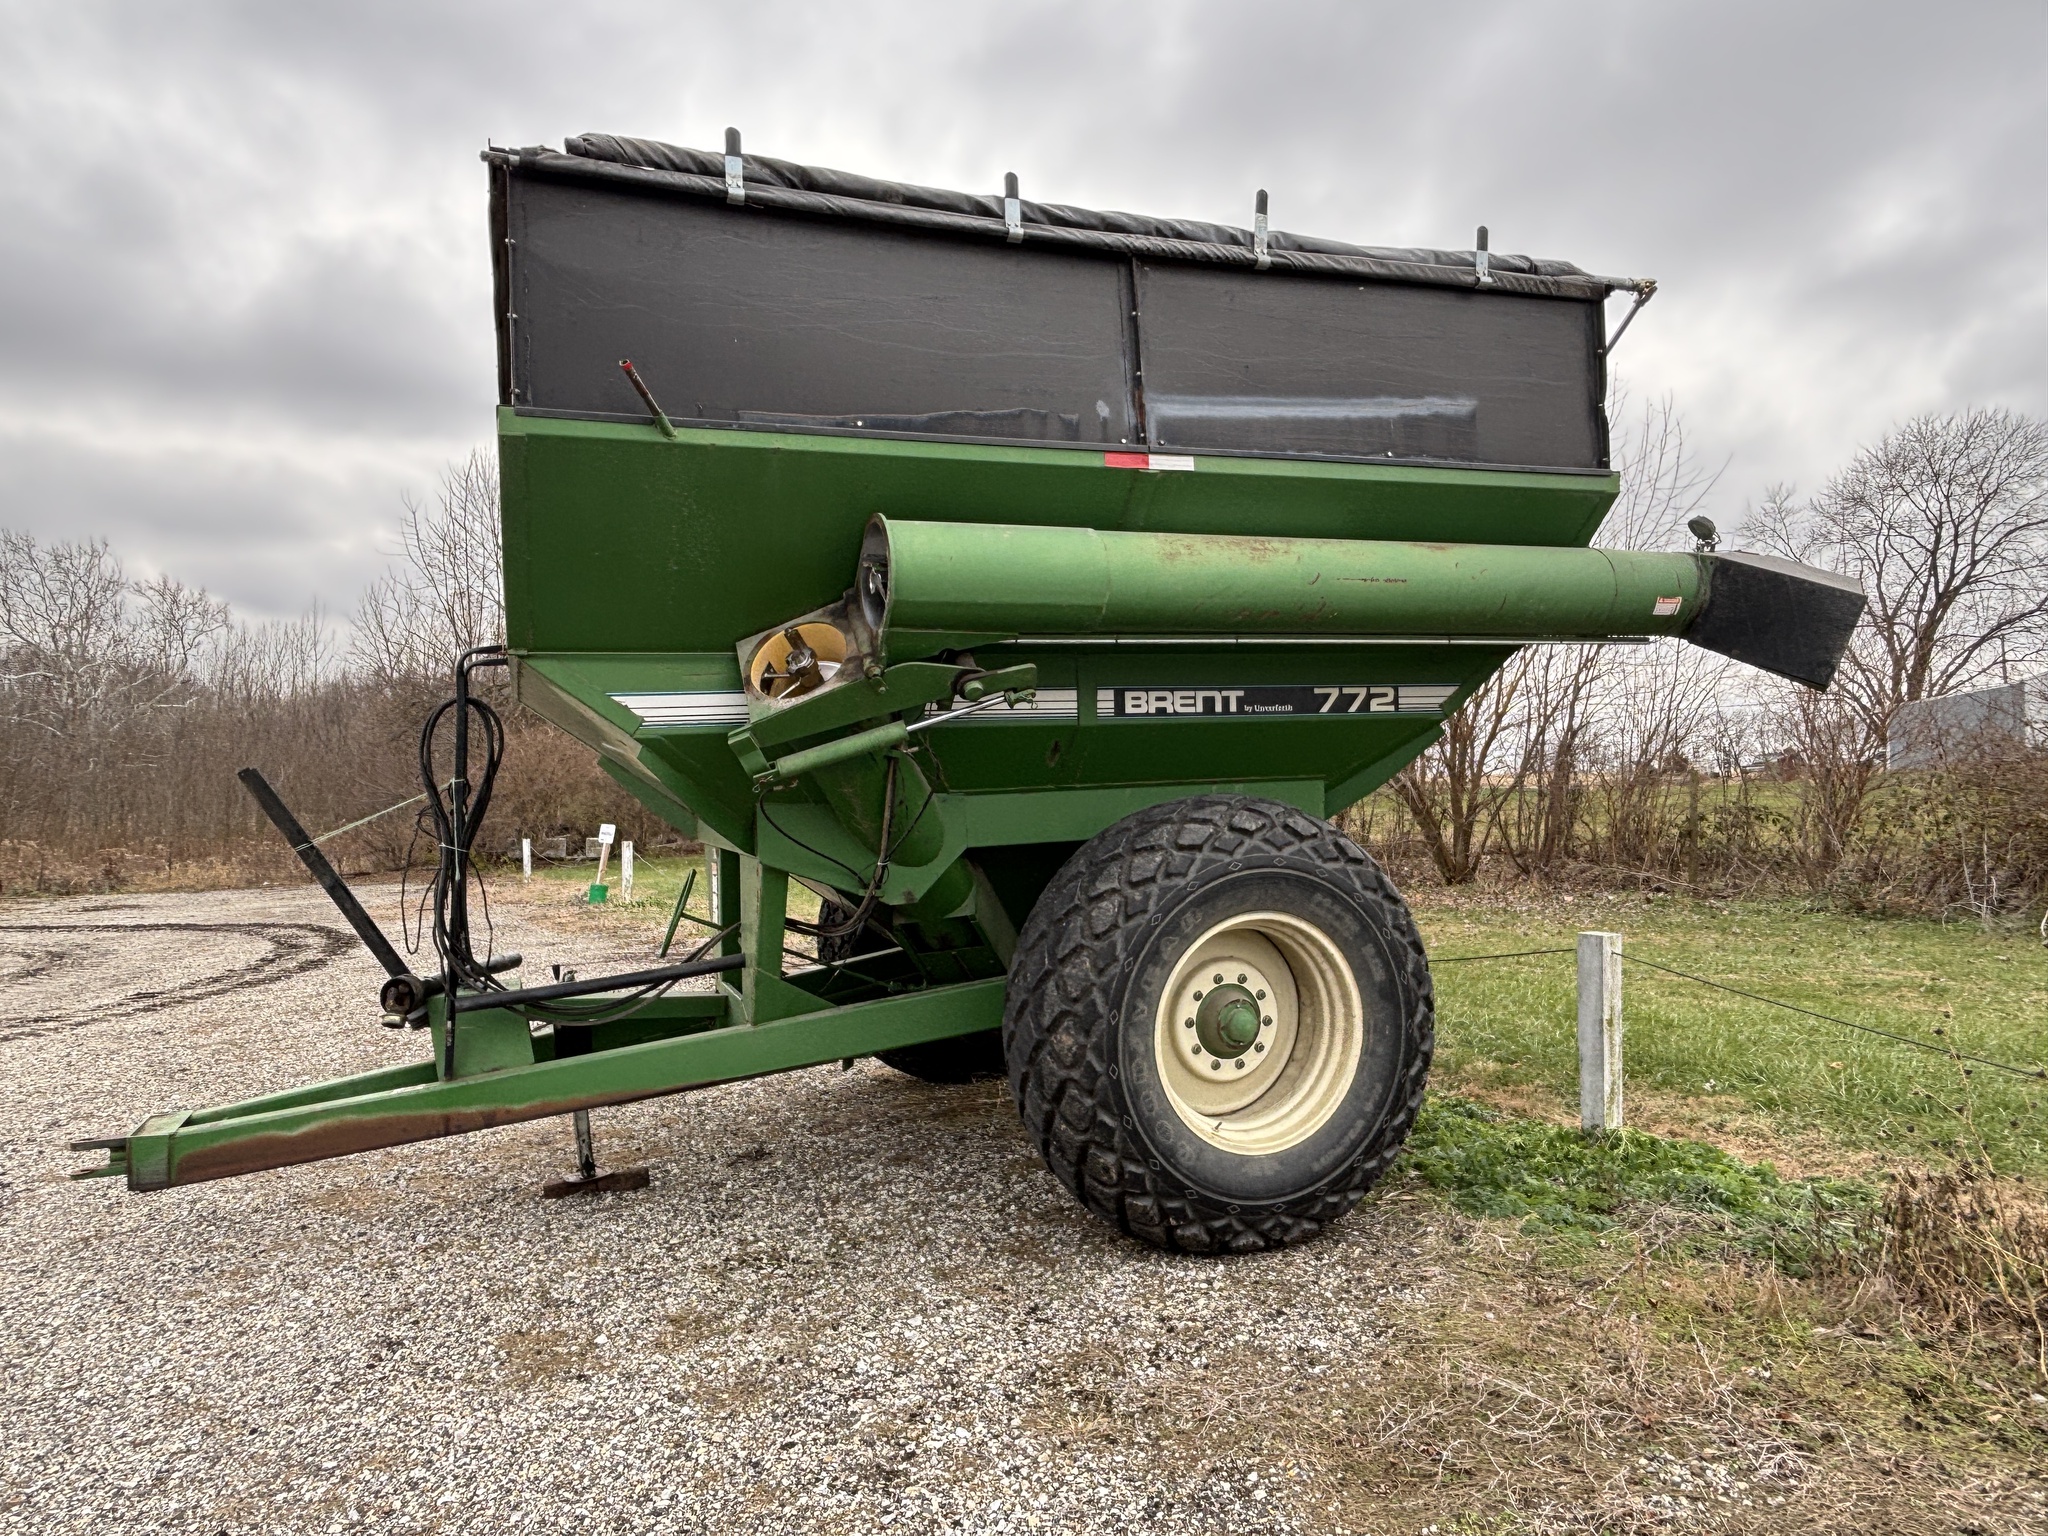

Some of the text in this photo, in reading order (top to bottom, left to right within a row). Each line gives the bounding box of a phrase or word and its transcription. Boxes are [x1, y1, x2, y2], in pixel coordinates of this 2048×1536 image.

[1124, 690, 1244, 713] BRENT
[1244, 704, 1253, 713] by
[1313, 686, 1395, 713] 772
